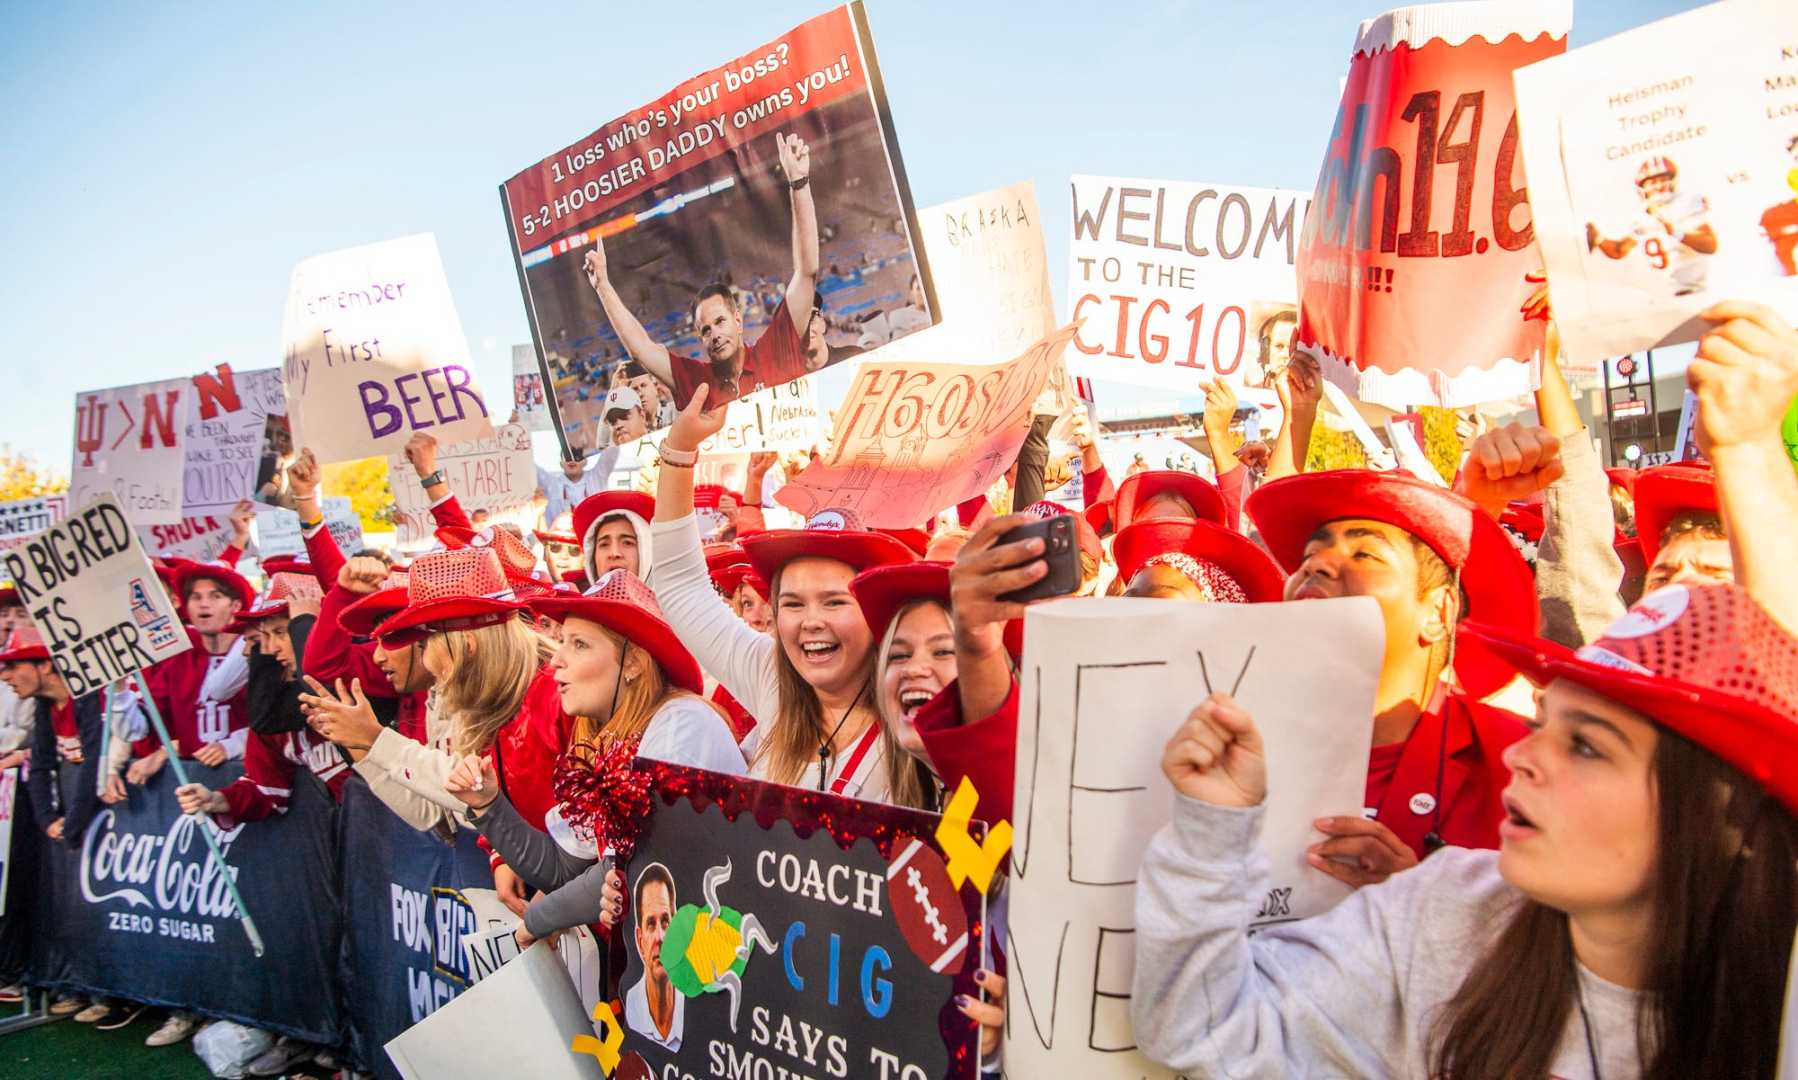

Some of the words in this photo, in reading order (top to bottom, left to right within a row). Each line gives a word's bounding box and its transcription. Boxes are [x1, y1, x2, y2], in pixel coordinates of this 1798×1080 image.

[551, 161, 564, 183] 1
[567, 143, 605, 172] loss
[607, 108, 668, 154] who's
[672, 80, 721, 124] your
[728, 43, 790, 92] boss?
[1608, 75, 1694, 108] Heisman
[1617, 102, 1688, 131] Trophy
[522, 209, 553, 236] 5-2
[554, 166, 644, 219] HOOSIER
[648, 113, 728, 172] DADDY
[732, 86, 794, 130] owns
[799, 54, 851, 104] you!
[1606, 125, 1708, 161] Candidate
[1071, 183, 1312, 265] WELCOM
[1643, 237, 1669, 270] 9
[1077, 257, 1121, 283] TO
[1137, 262, 1196, 290] THE
[323, 329, 384, 368] First
[1071, 293, 1247, 376] CIG10
[140, 391, 180, 449] N
[192, 362, 242, 420] N
[357, 364, 489, 439] BEER
[462, 456, 513, 498] TABLE
[27, 527, 79, 590] BIG
[67, 503, 130, 567] RED
[34, 597, 82, 652] IS
[52, 621, 156, 697] BETTER
[80, 809, 246, 920] Coca-Cola
[756, 850, 884, 918] COACH
[109, 911, 153, 934] ZERO
[159, 919, 216, 944] SUGAR
[391, 883, 432, 954] FOX
[783, 920, 895, 1020] CIG
[751, 1006, 848, 1079] SAYS
